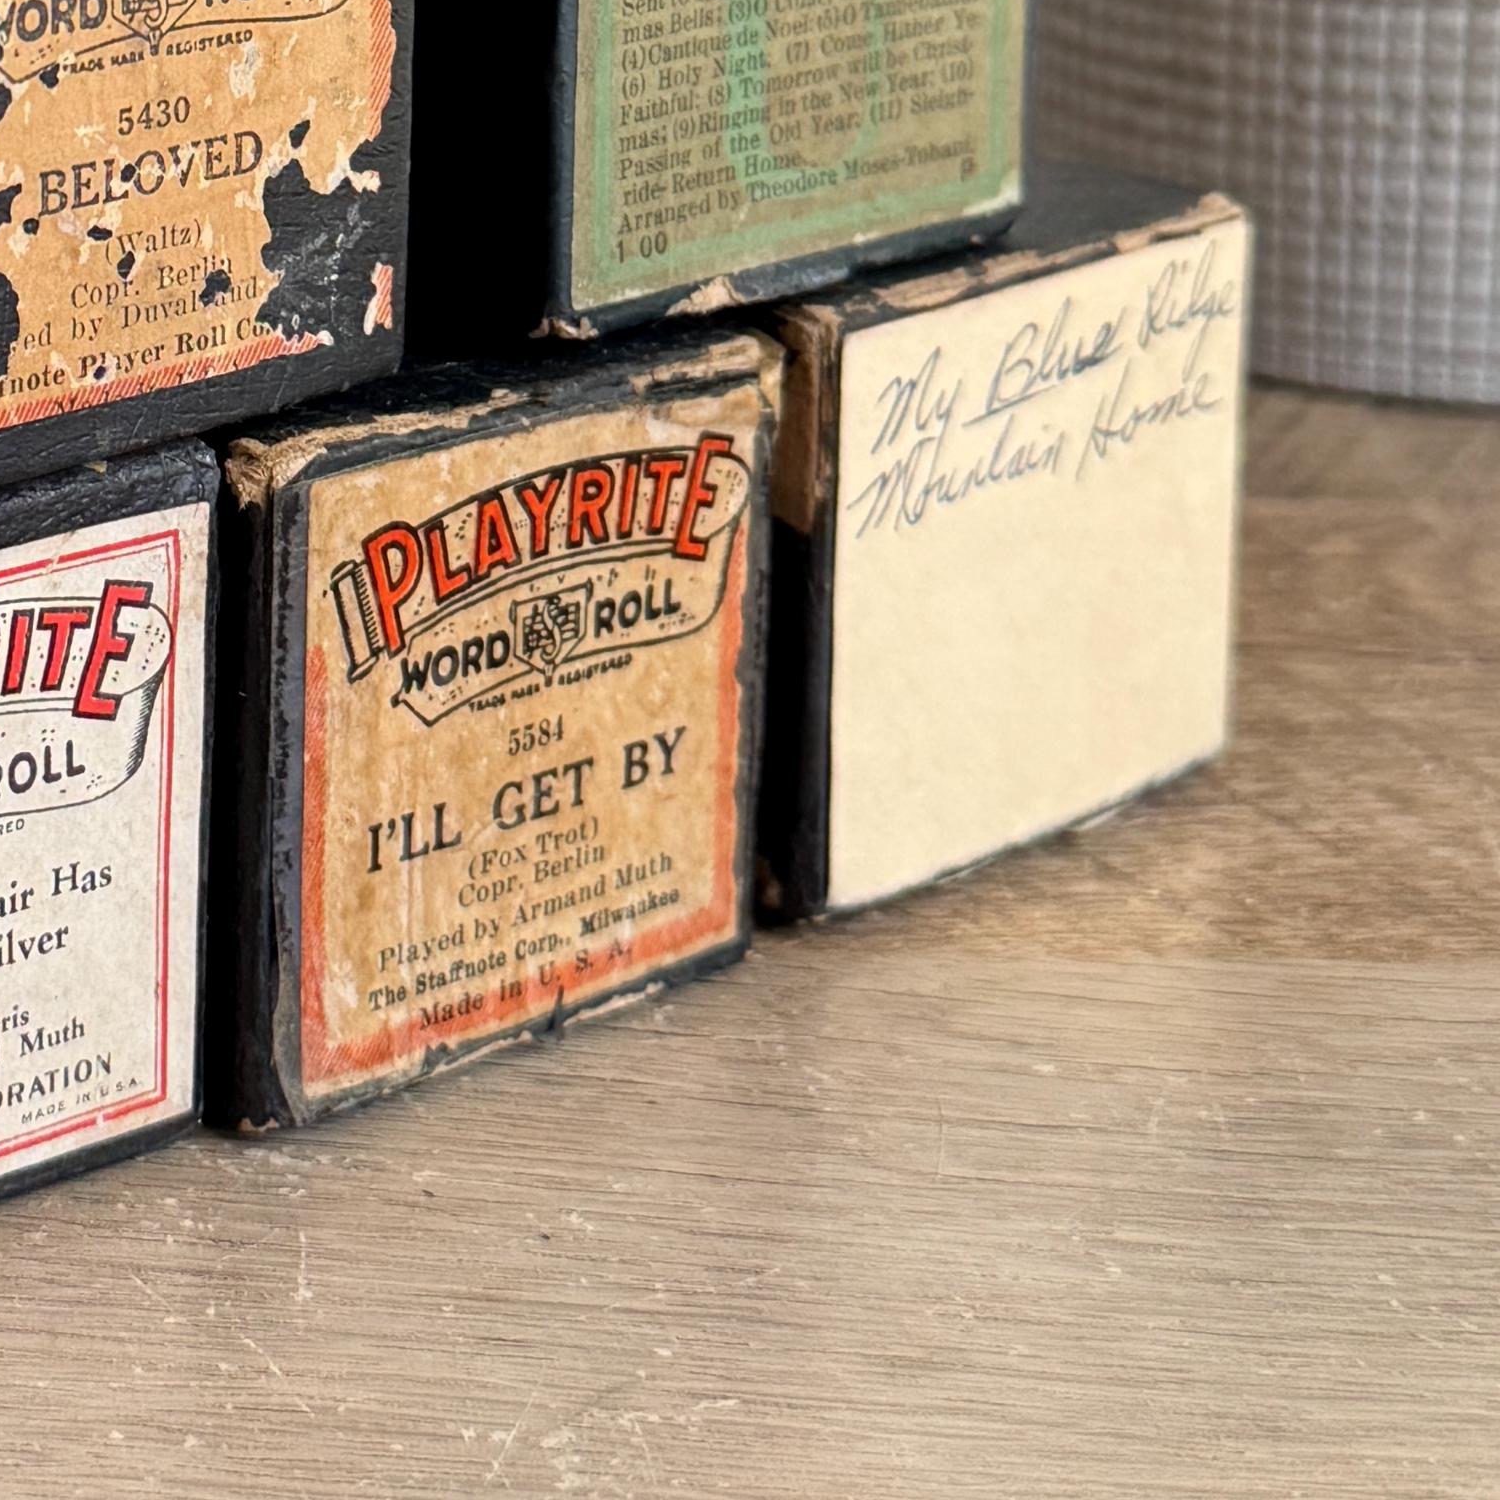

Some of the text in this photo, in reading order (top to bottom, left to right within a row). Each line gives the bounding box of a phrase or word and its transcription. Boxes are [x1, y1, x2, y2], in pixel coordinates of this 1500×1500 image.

[110, 49, 146, 67] MARK
[165, 28, 254, 57] REGISTERED
[622, 20, 664, 41] mas
[736, 26, 759, 44] de
[621, 75, 646, 98] (6)
[657, 63, 702, 89] Holy
[785, 41, 810, 63] (7)
[707, 83, 732, 105] (8)
[738, 60, 841, 98] Tomorrow
[117, 96, 191, 137] 5430
[778, 96, 795, 115] in
[801, 89, 832, 110] the
[840, 78, 879, 102] New
[38, 129, 264, 217] BELOVED
[618, 147, 692, 179] Passing
[701, 140, 721, 159] of
[729, 131, 761, 153] the
[769, 122, 802, 144] Old
[617, 195, 711, 235] Arranged
[716, 188, 742, 212] by
[745, 165, 838, 204] Theodore
[671, 163, 736, 193] Return
[104, 220, 203, 265] (Waltz)
[70, 277, 141, 310] Copr.
[71, 317, 103, 342] by
[121, 291, 198, 330] Duval
[174, 323, 227, 355] Roll
[870, 239, 1235, 485] My Blue Ridge
[847, 358, 1222, 539] Mountain Home
[362, 431, 734, 659] PLAYRITE
[399, 578, 682, 694] WORD ROLL
[508, 714, 564, 756] 5584
[366, 725, 688, 874] I'LL GET BY
[468, 816, 600, 880] (Fox Trot)
[52, 860, 113, 897] Has
[458, 844, 606, 908] Copr. Berlin
[378, 853, 673, 972] Played by Armand Muth
[368, 984, 408, 1012] The
[415, 948, 507, 996] Staffnote
[579, 887, 681, 937] Milwaukee
[419, 991, 485, 1031] Made
[499, 977, 524, 1003] in
[19, 1017, 85, 1057] Muth
[20, 1091, 92, 1124] MADE IN
